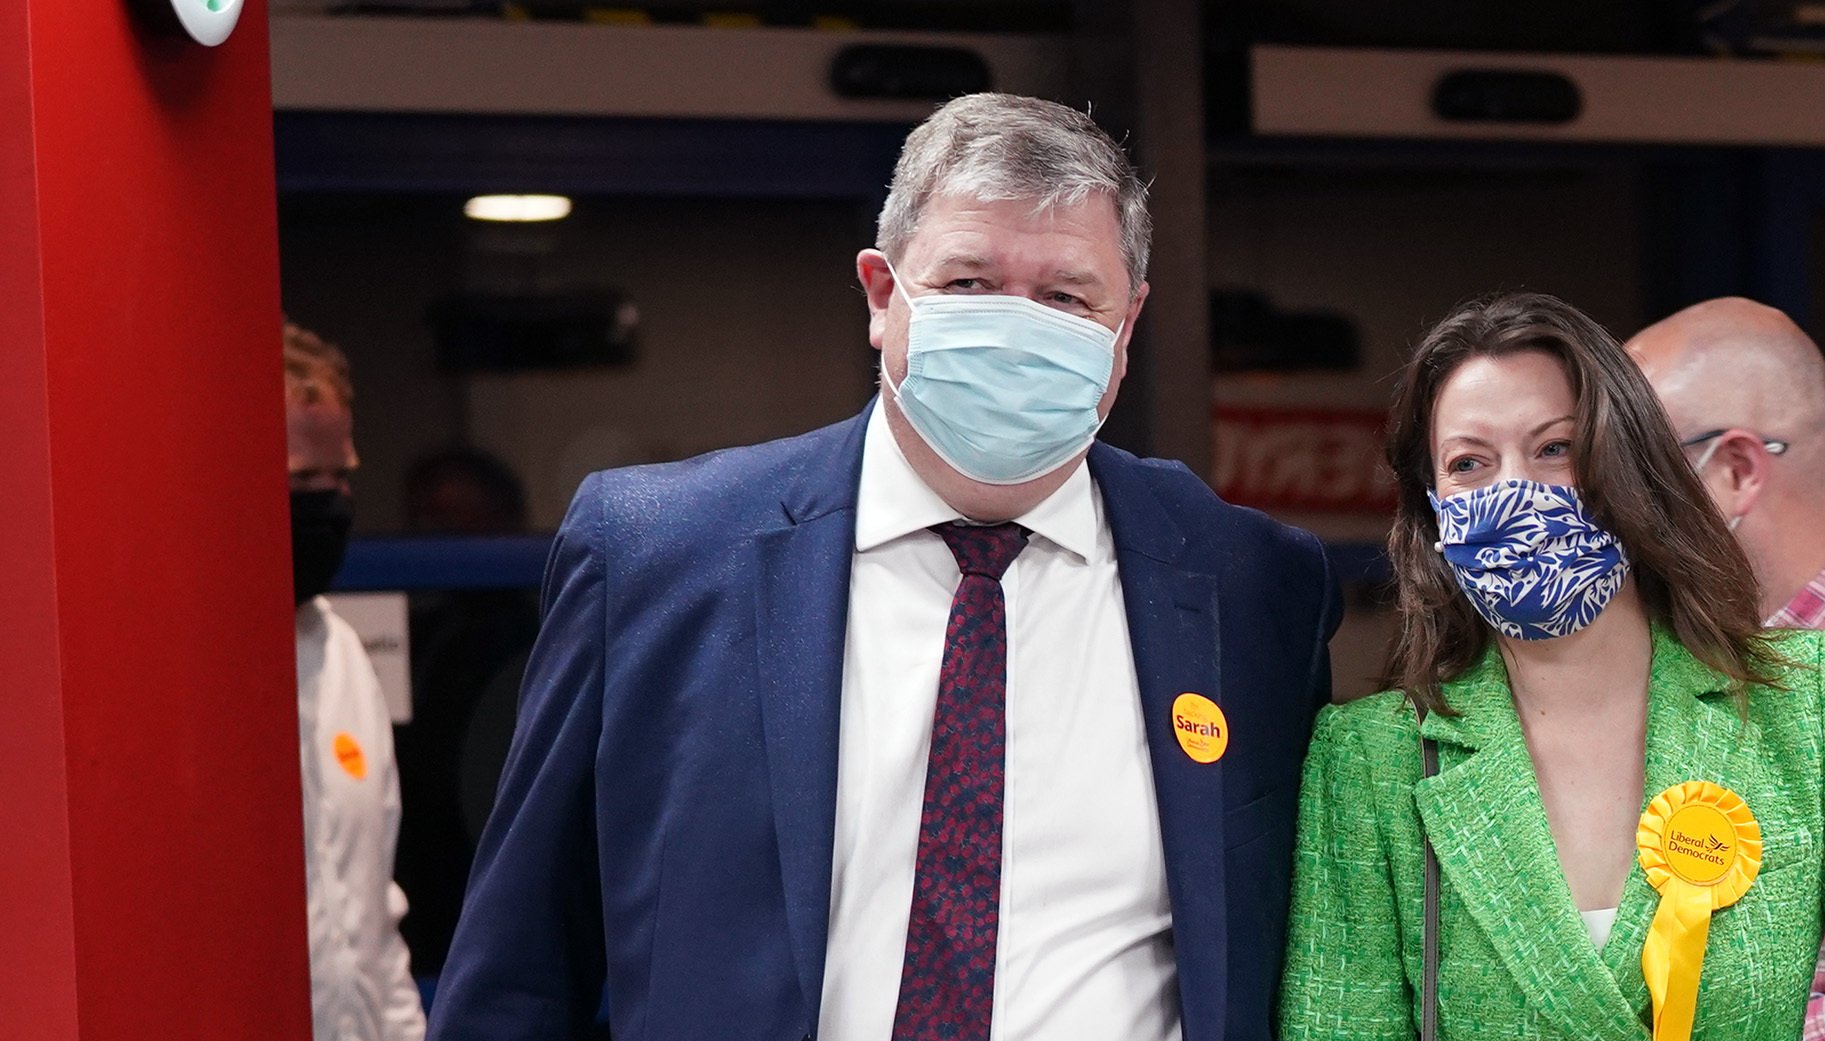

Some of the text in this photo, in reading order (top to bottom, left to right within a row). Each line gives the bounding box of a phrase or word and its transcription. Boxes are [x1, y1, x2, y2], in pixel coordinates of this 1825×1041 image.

[1176, 714, 1221, 739] Sarah
[1670, 830, 1705, 848] Liberal
[1668, 840, 1725, 866] Democrats
